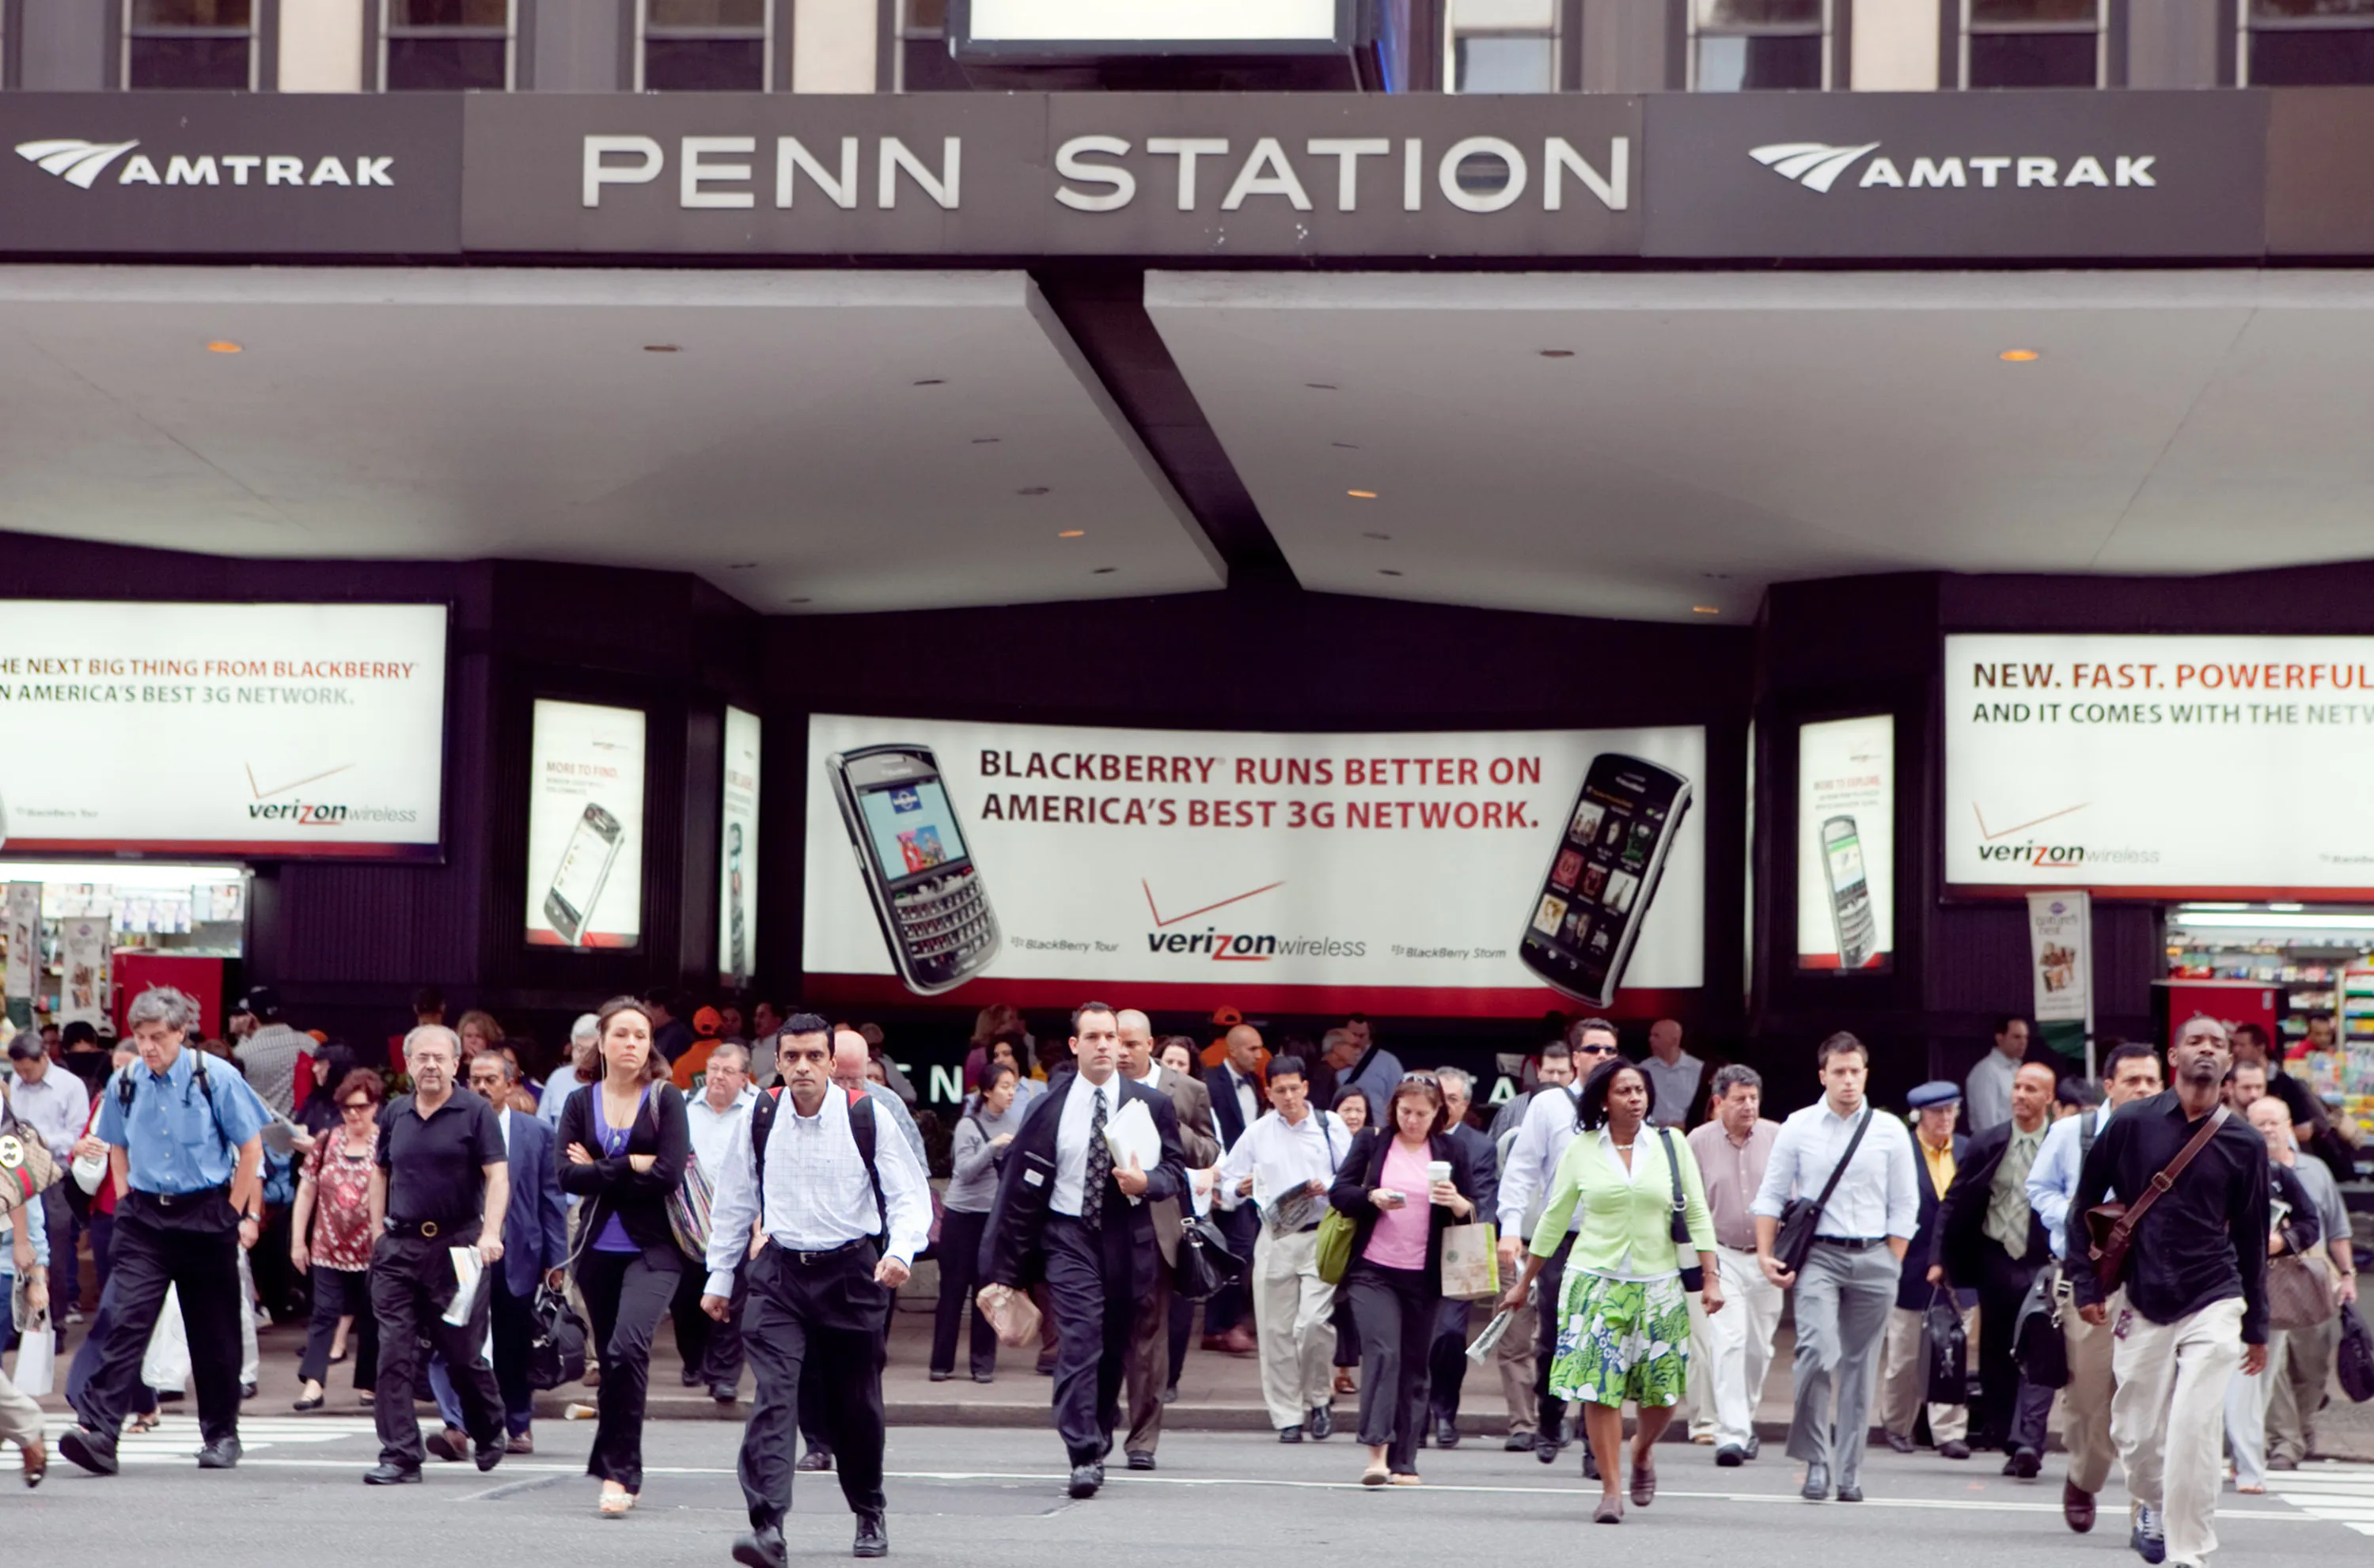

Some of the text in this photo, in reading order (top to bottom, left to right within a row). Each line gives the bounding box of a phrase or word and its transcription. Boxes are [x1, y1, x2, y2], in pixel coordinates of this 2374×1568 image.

[119, 155, 394, 186] AMTRAK
[582, 135, 1629, 212] PENN STATION
[1859, 156, 2156, 188] AMTRAK
[27, 658, 82, 675] NEXT
[89, 659, 124, 676] BIG
[130, 659, 198, 676] THING
[204, 661, 267, 678] FROM
[274, 661, 415, 679] BLACKBERRY
[1974, 663, 2374, 690] NEW. FAST. POWERFUL
[18, 685, 136, 702] AMERICA'S
[142, 686, 196, 703] BEST
[203, 687, 231, 703] 3G
[237, 687, 355, 706] NETWORK.
[1973, 703, 2031, 722] AND
[2039, 703, 2061, 722] IT
[2070, 703, 2162, 723] COMES
[2170, 704, 2239, 723] WITH
[2247, 704, 2298, 724] THE
[547, 761, 575, 775] MORE
[578, 763, 591, 776] TO
[980, 750, 1542, 786] BLACKBERRY RUNS BETTER ON
[249, 798, 417, 825] verizon wireless
[981, 793, 1538, 829] AMERICA'S BEST 3G NETWORK.
[1978, 839, 2084, 867] verizon
[1026, 939, 1120, 954] BlackBerry Tour
[1147, 926, 1367, 960] verizon wireless
[1406, 947, 1507, 961] BlackBerry Storm
